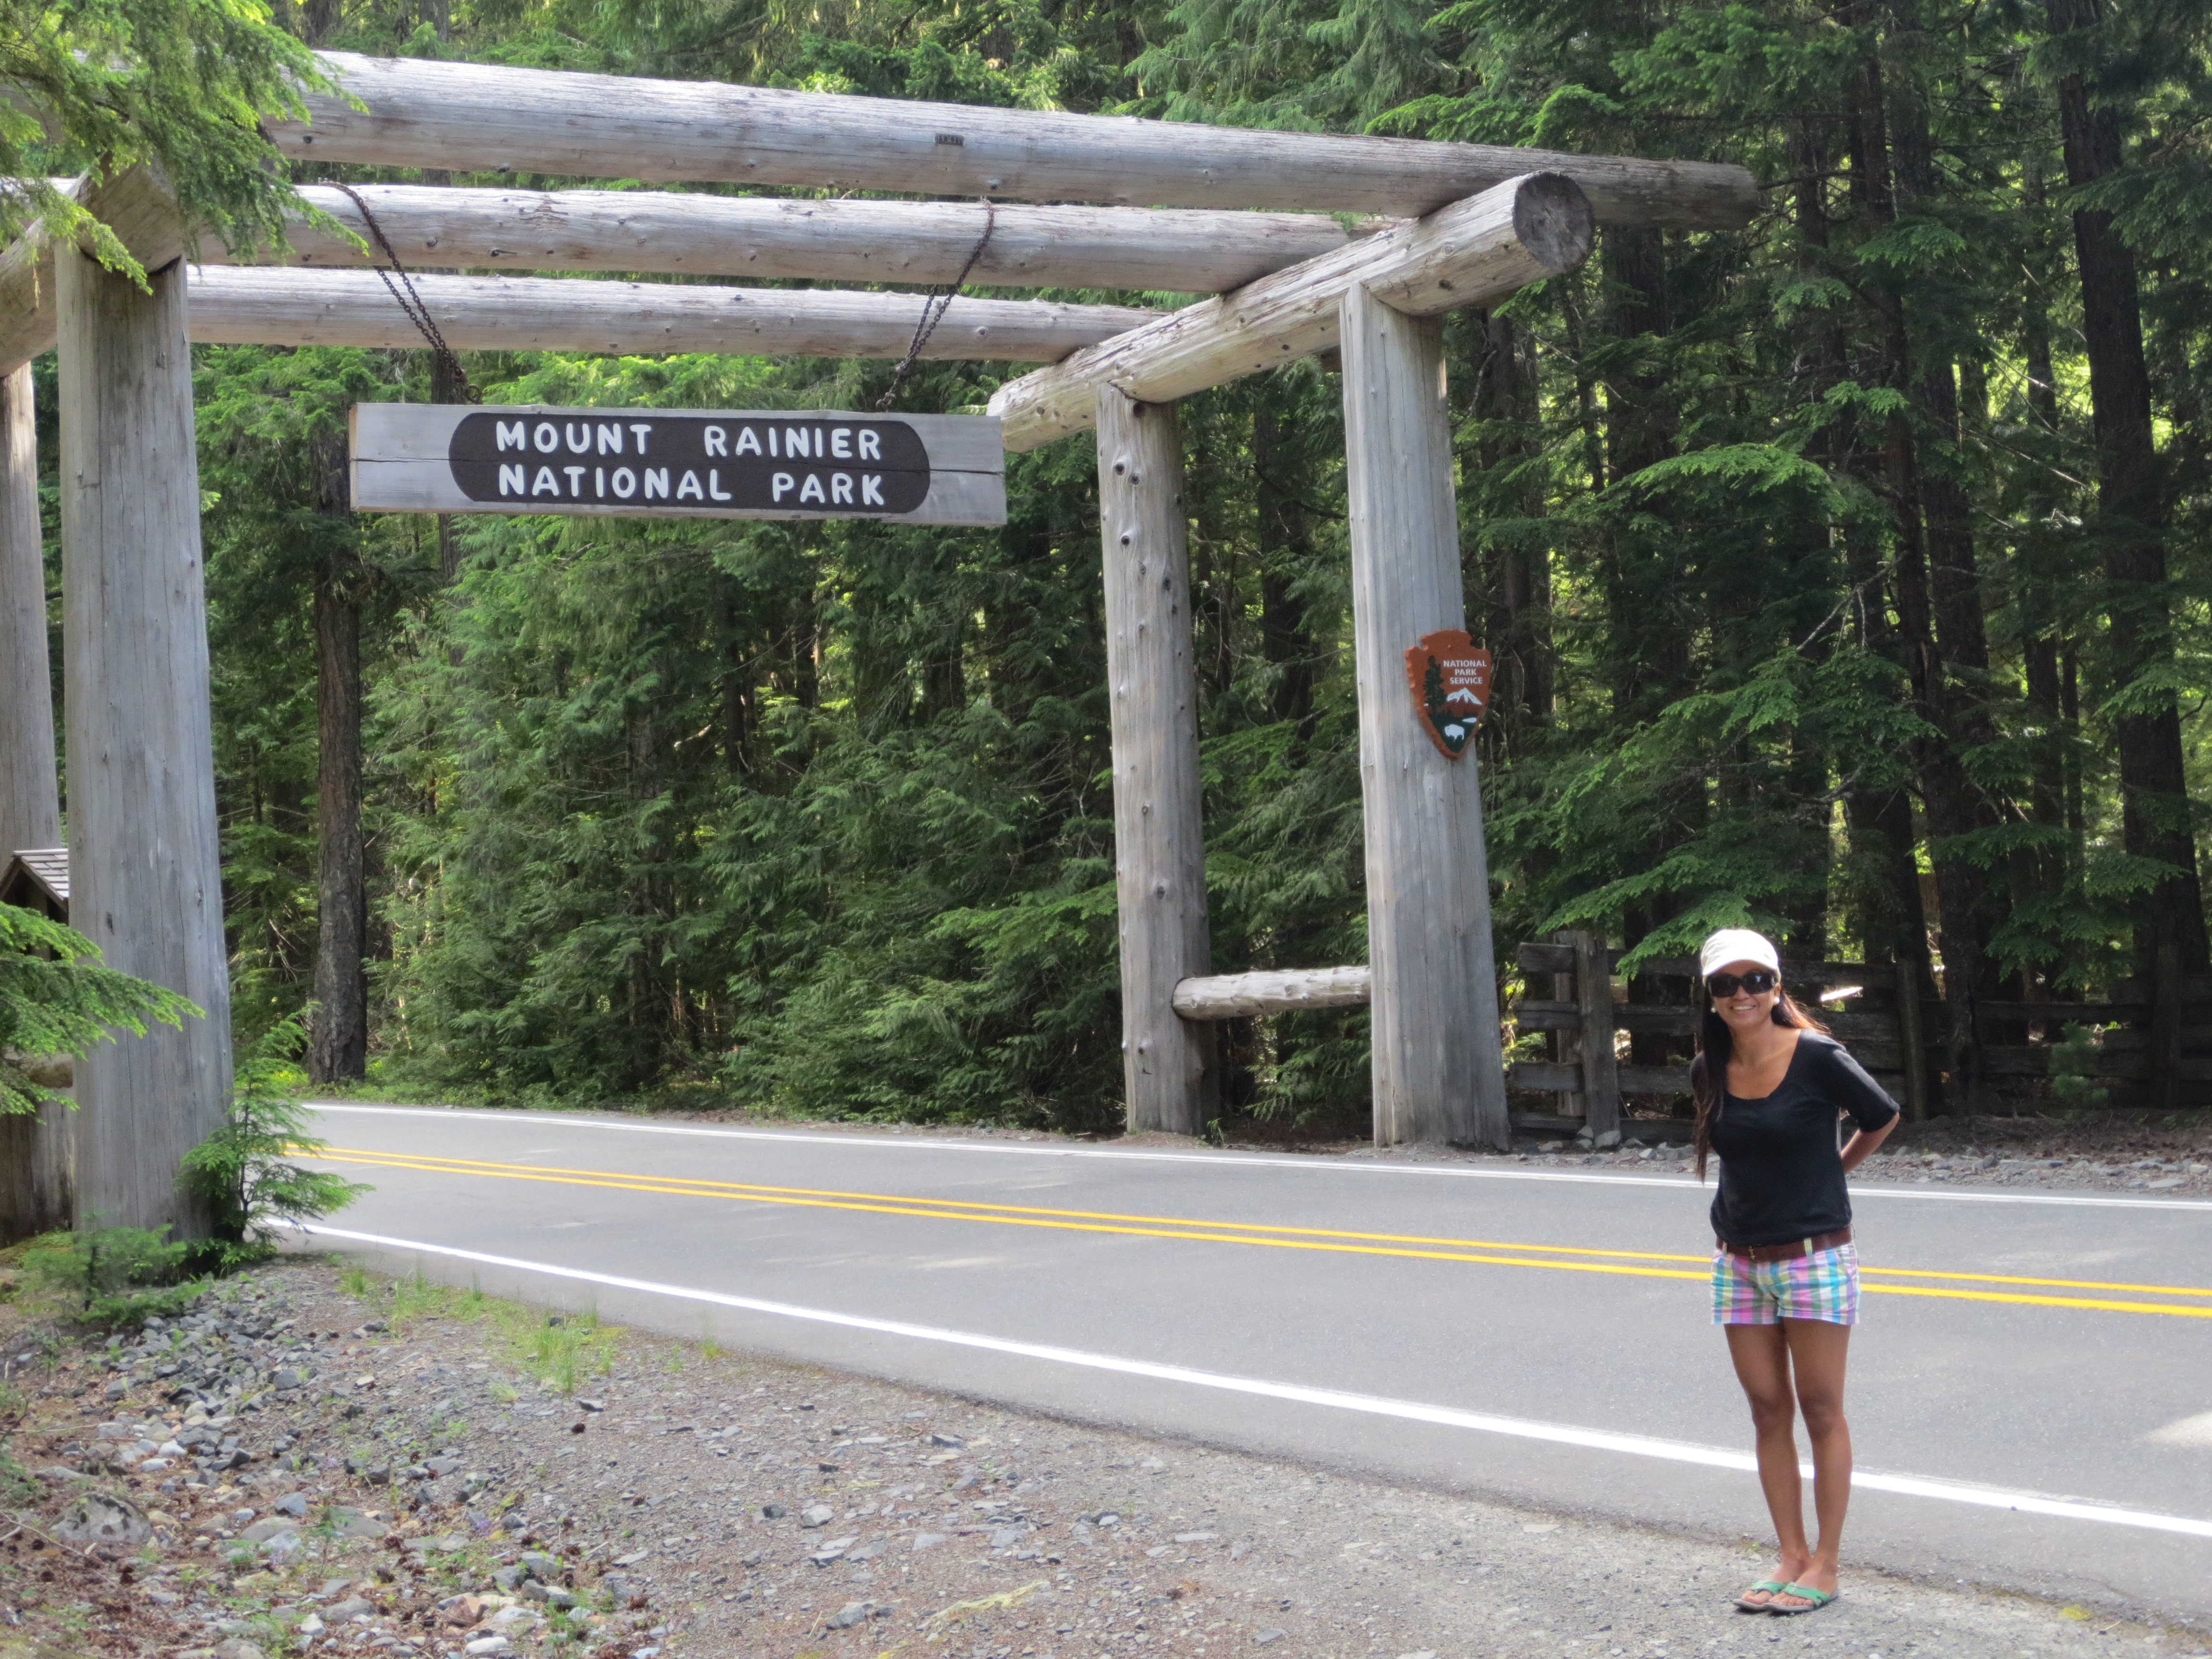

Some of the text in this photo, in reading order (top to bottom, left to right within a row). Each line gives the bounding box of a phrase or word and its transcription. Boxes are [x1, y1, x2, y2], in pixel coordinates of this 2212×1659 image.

[496, 421, 881, 460] MOUNT RAINIER
[498, 464, 884, 505] NATIONAL PARK
